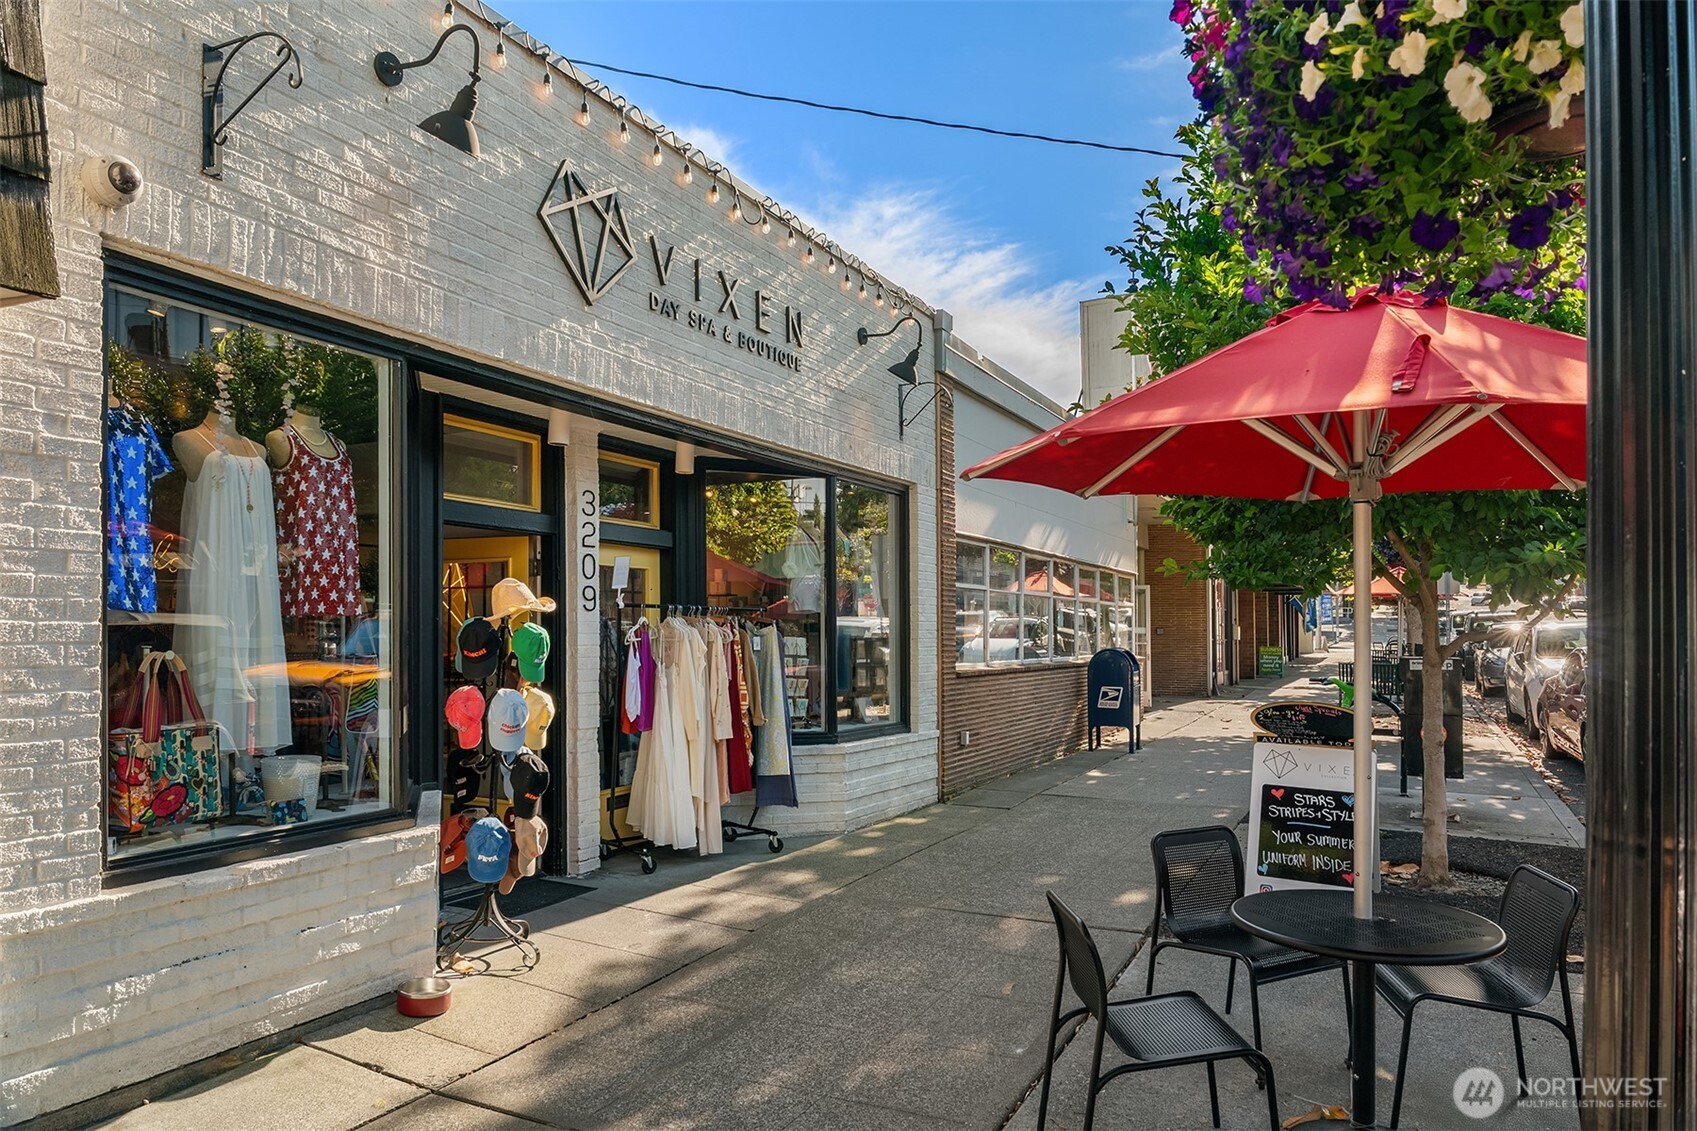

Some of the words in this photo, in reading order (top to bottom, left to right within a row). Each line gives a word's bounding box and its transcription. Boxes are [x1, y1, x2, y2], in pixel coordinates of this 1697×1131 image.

[649, 234, 804, 348] VIXEN
[649, 291, 682, 321] DAY
[688, 308, 717, 338] SPA
[722, 323, 733, 344] &
[737, 329, 803, 374] BOUTIQUE
[581, 489, 597, 612] 3209
[1261, 736, 1322, 745] AVAILABLE
[1303, 762, 1353, 776] VIXE
[1293, 793, 1336, 808] STARS
[1268, 804, 1315, 819] STRIPES
[1271, 829, 1302, 845] YOUR
[1262, 850, 1307, 868] UNIFORM
[1312, 854, 1352, 873] INSIDE
